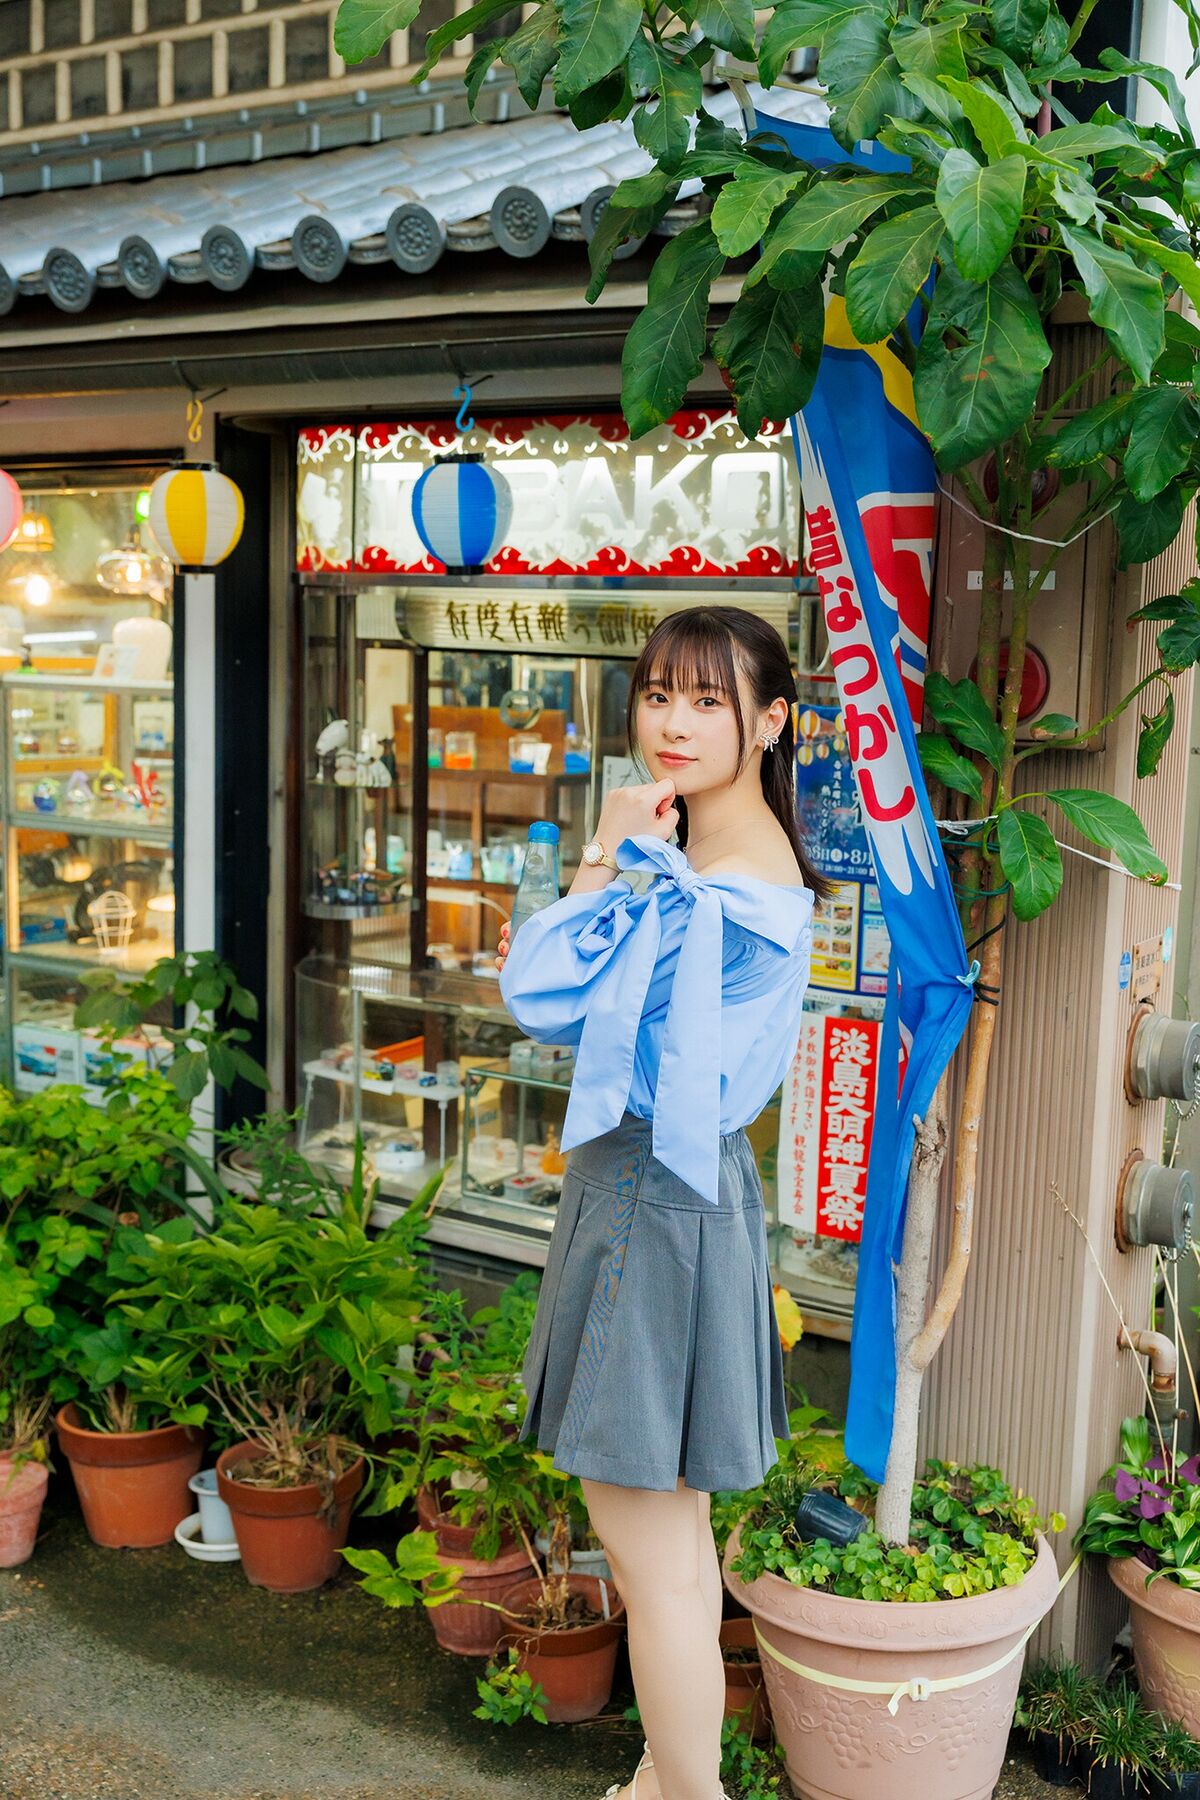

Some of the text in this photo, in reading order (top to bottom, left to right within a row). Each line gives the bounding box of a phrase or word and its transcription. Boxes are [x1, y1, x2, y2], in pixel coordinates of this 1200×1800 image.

[362, 451, 788, 531] TBAKO
[805, 504, 917, 822] 昔なつかし
[819, 1027, 872, 1232] 淡島大明神夏祭
